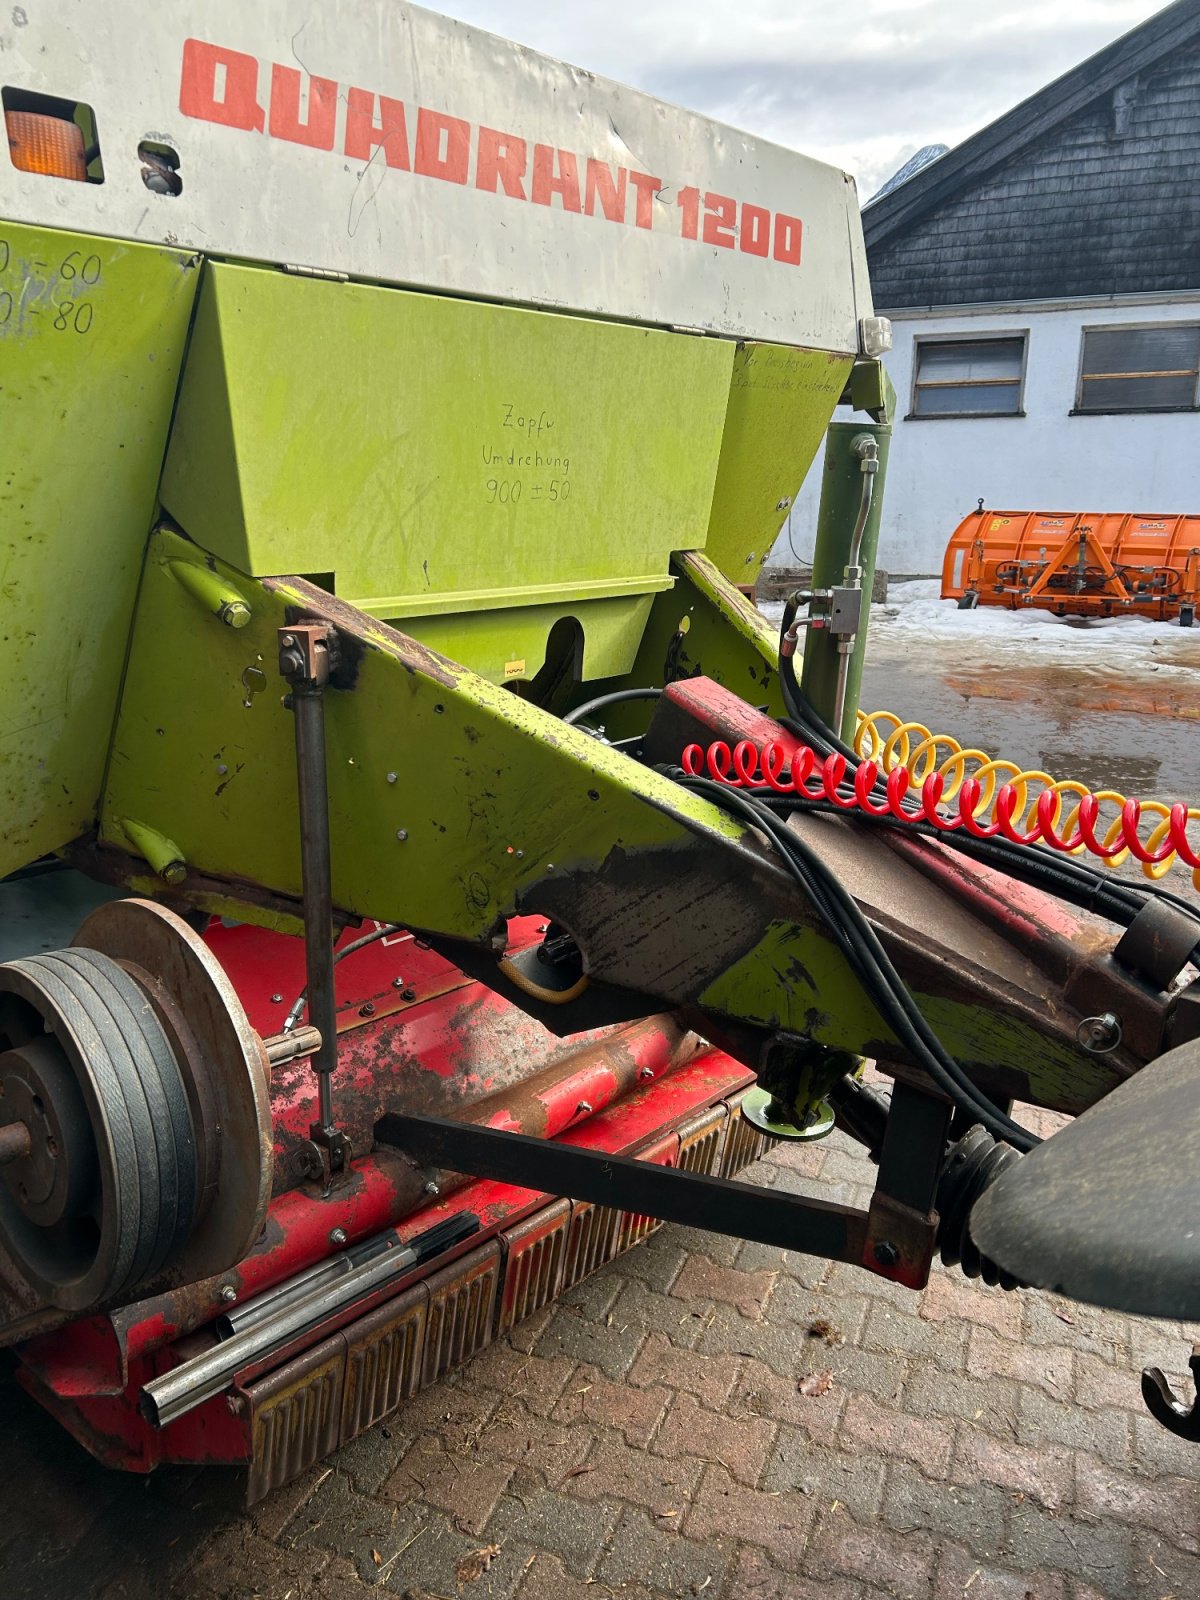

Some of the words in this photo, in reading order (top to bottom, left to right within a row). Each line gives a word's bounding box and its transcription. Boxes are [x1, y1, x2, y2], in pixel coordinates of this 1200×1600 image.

[179, 38, 661, 230] QUADRANT
[677, 185, 802, 266] 1200
[60, 251, 101, 285] 60
[53, 301, 93, 334] 80
[482, 444, 570, 476] Umdrehung
[486, 479, 522, 504] 900
[549, 479, 571, 502] 50
